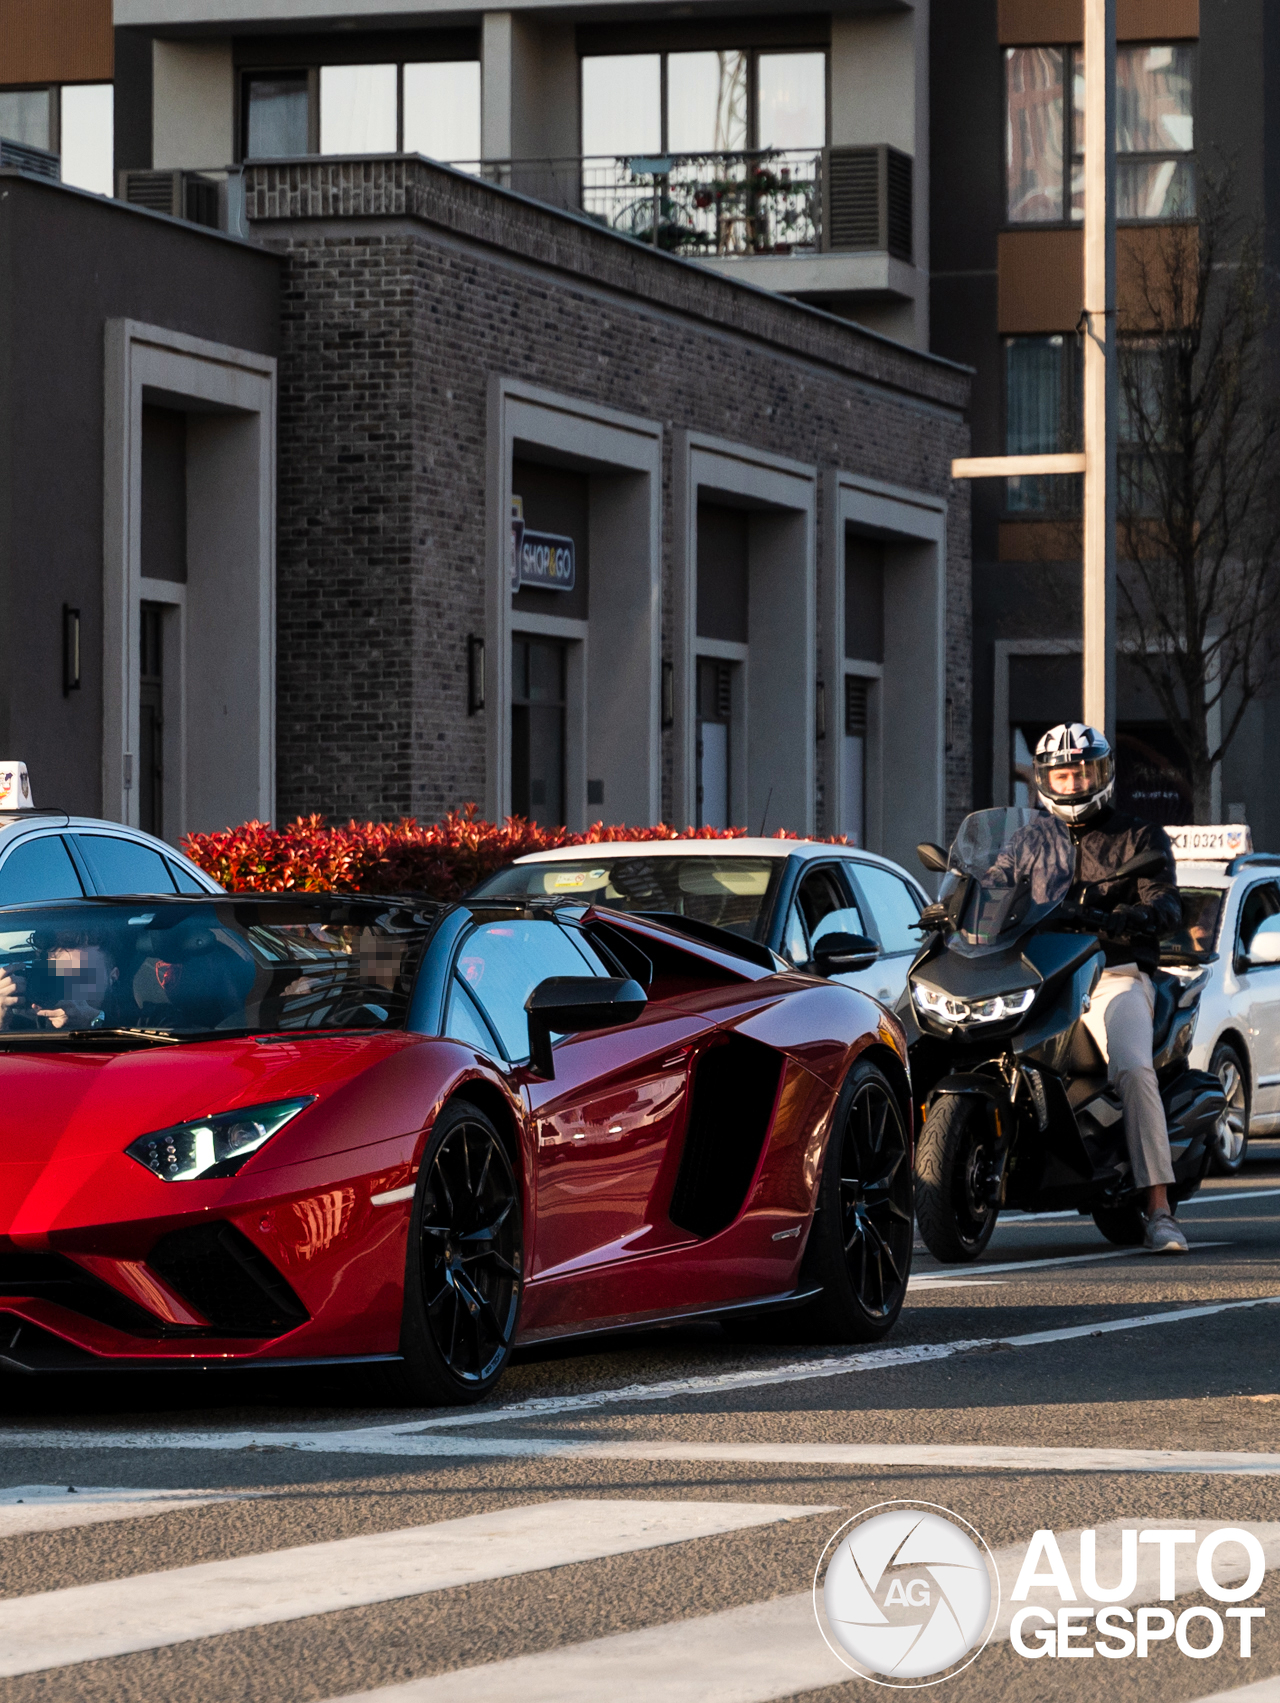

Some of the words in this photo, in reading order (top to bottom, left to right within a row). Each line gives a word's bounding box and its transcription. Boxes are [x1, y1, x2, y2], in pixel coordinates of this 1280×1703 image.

[523, 543, 571, 578] SHOP&GO
[1170, 833, 1188, 849] XI
[1193, 833, 1224, 849] 0321
